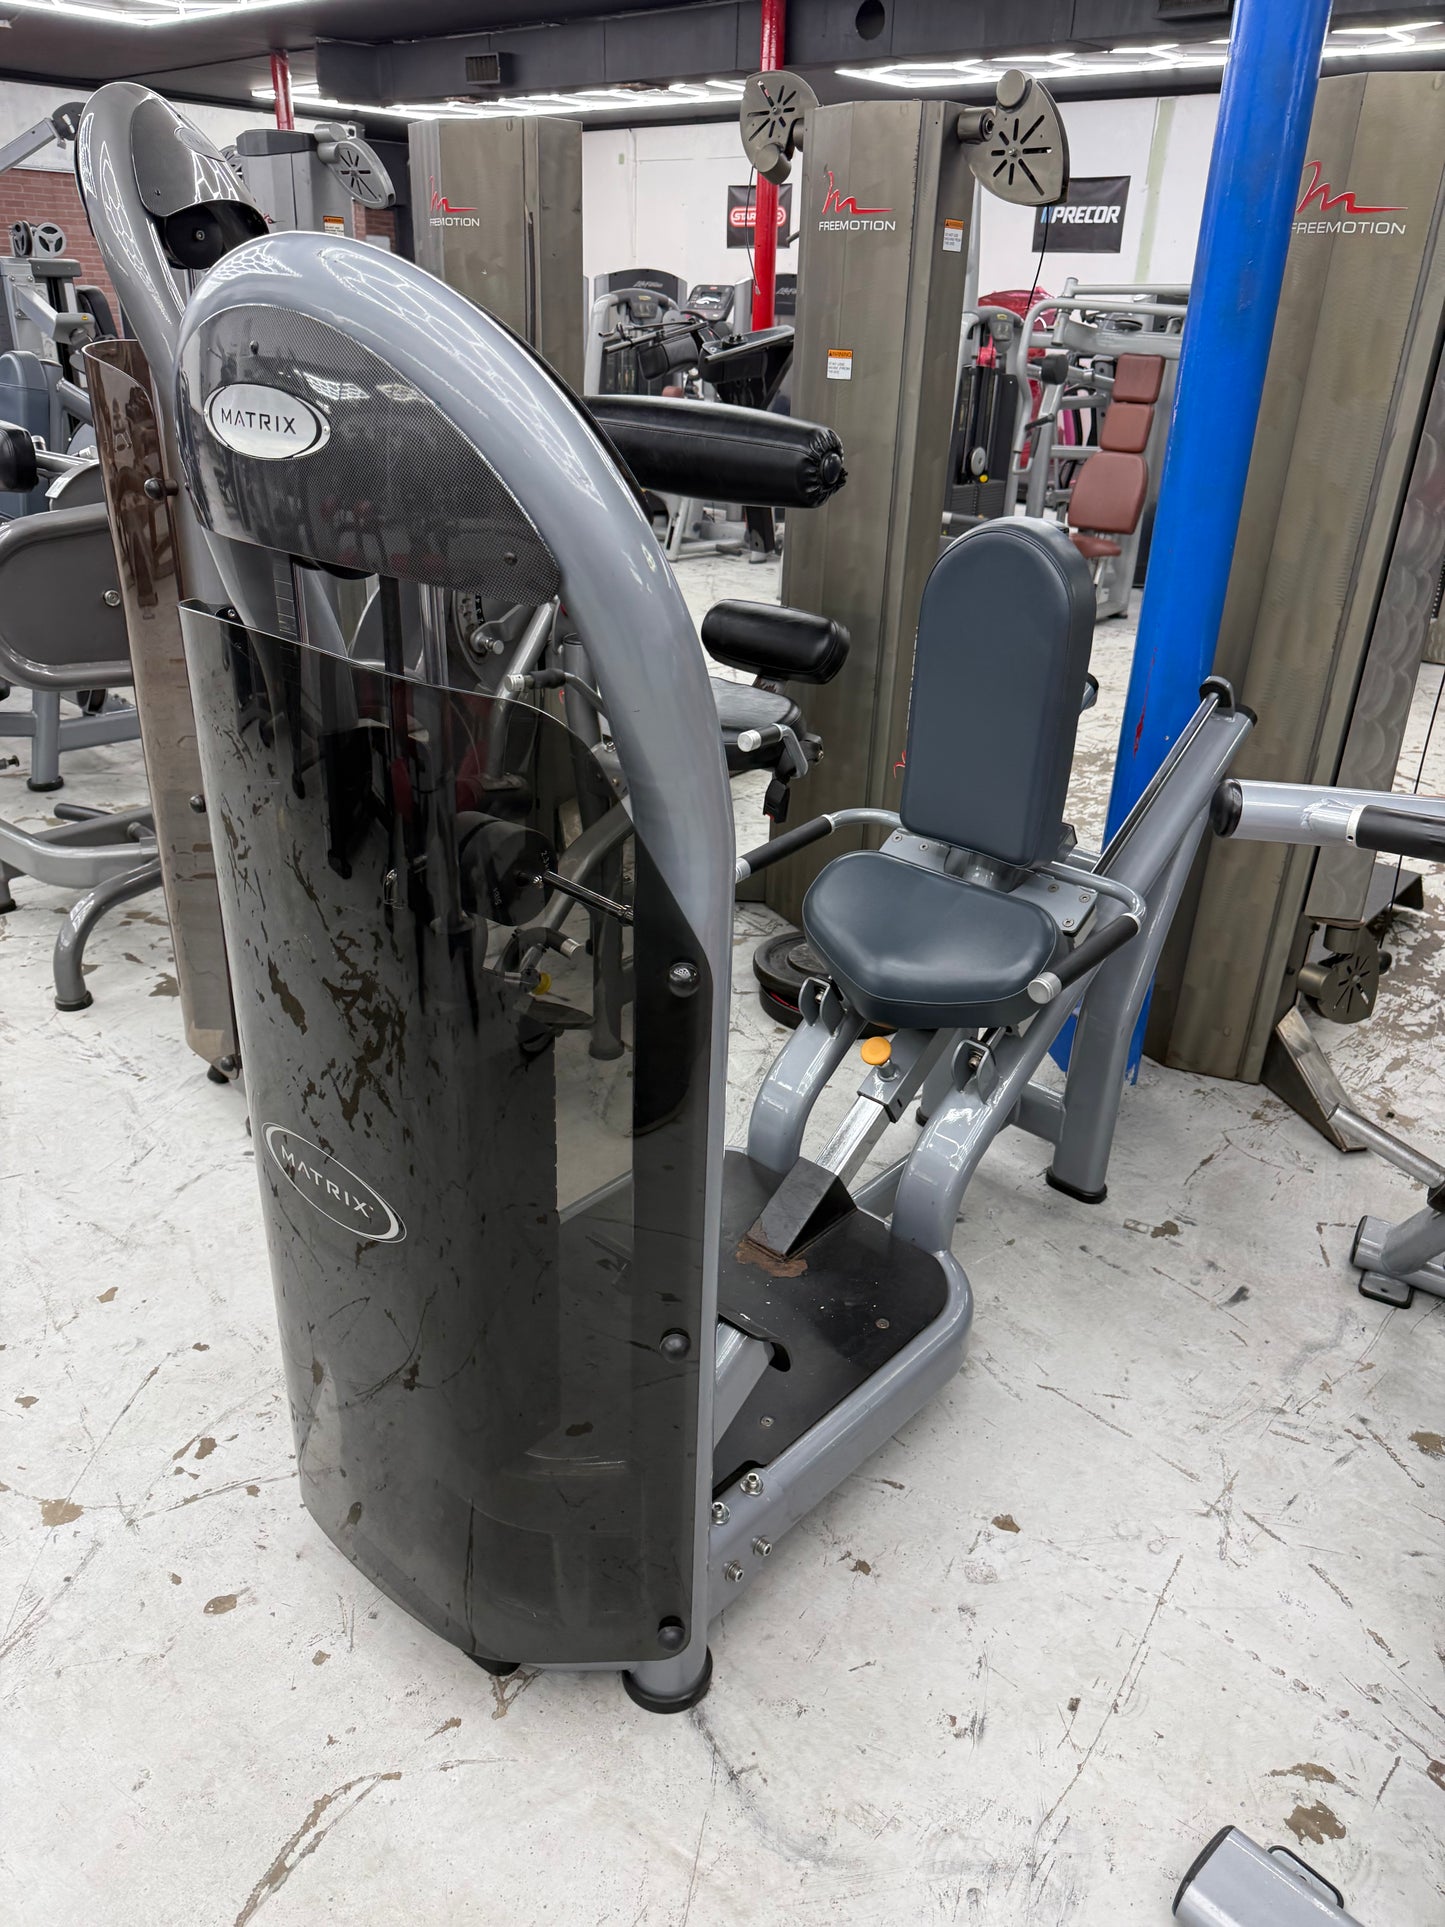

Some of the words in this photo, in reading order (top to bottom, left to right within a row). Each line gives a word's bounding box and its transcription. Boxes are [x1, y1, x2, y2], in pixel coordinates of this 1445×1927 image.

[818, 220, 896, 231] FREEMOTION
[1050, 205, 1121, 224] PRECOR
[221, 407, 297, 435] MATRIX
[280, 1144, 370, 1218] MATRIX
